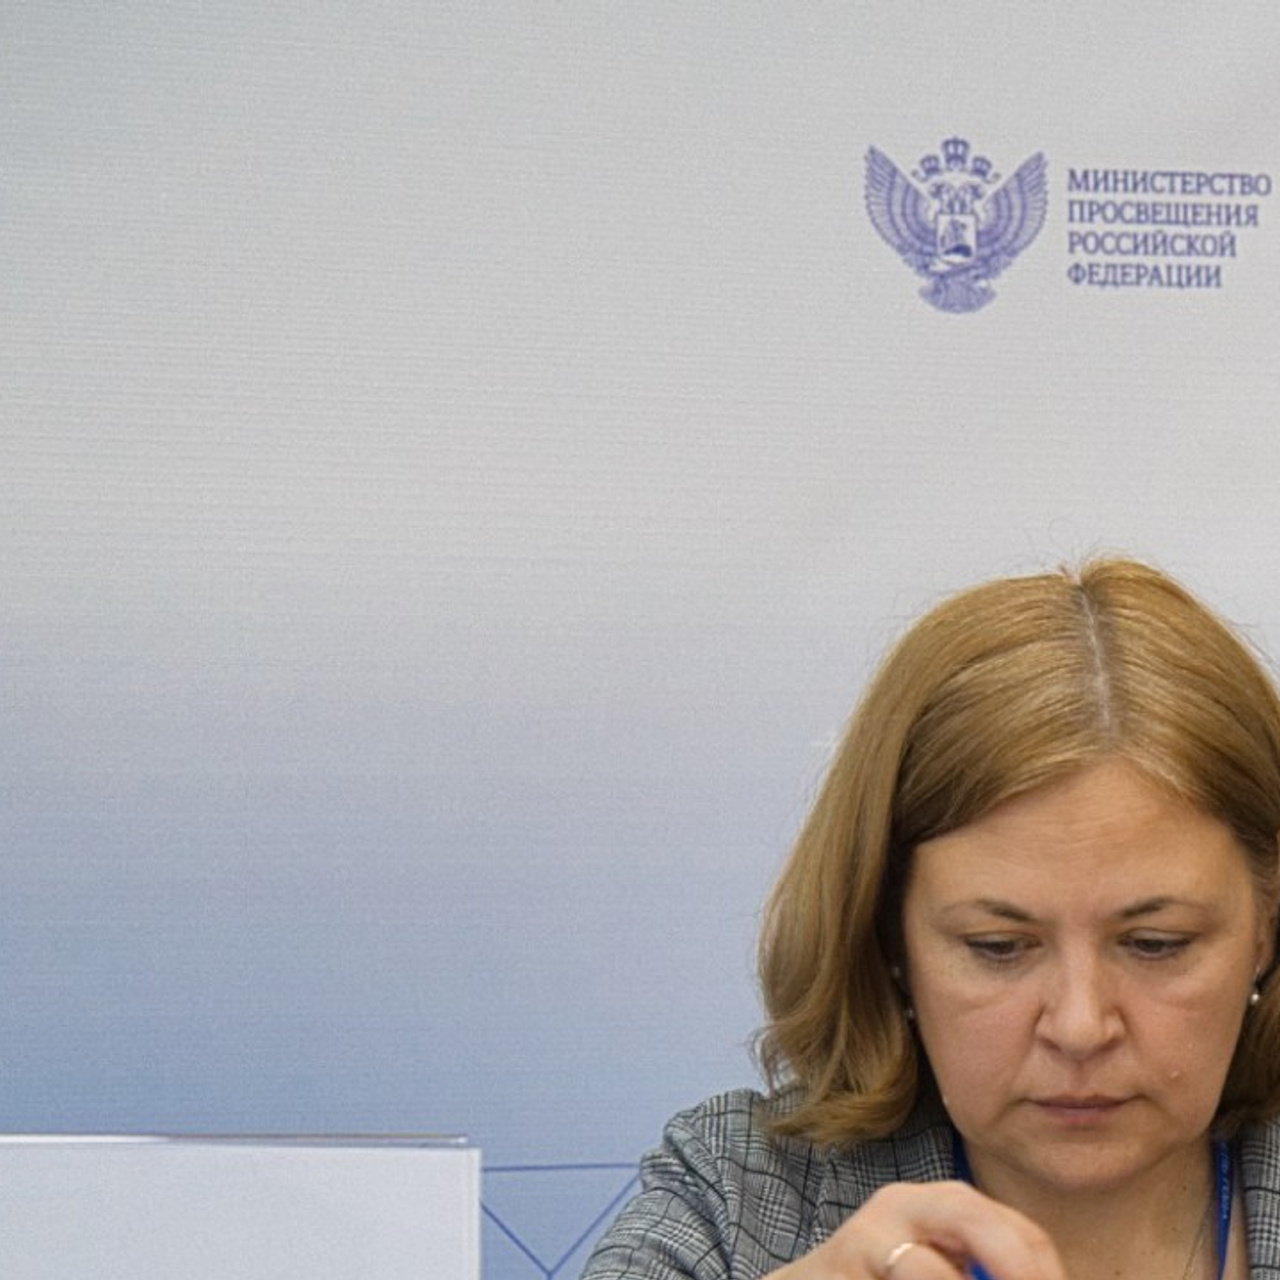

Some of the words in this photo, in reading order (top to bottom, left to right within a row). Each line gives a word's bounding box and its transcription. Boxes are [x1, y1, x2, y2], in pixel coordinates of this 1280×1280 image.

[1067, 168, 1272, 196] МИНИСТЕРСТВО
[1067, 199, 1258, 227] ПРОСВЕЩЕНИЯ
[1067, 230, 1236, 257] РОССИЙСКОЙ
[1067, 262, 1221, 289] ФЕДЕРАЦИИ
